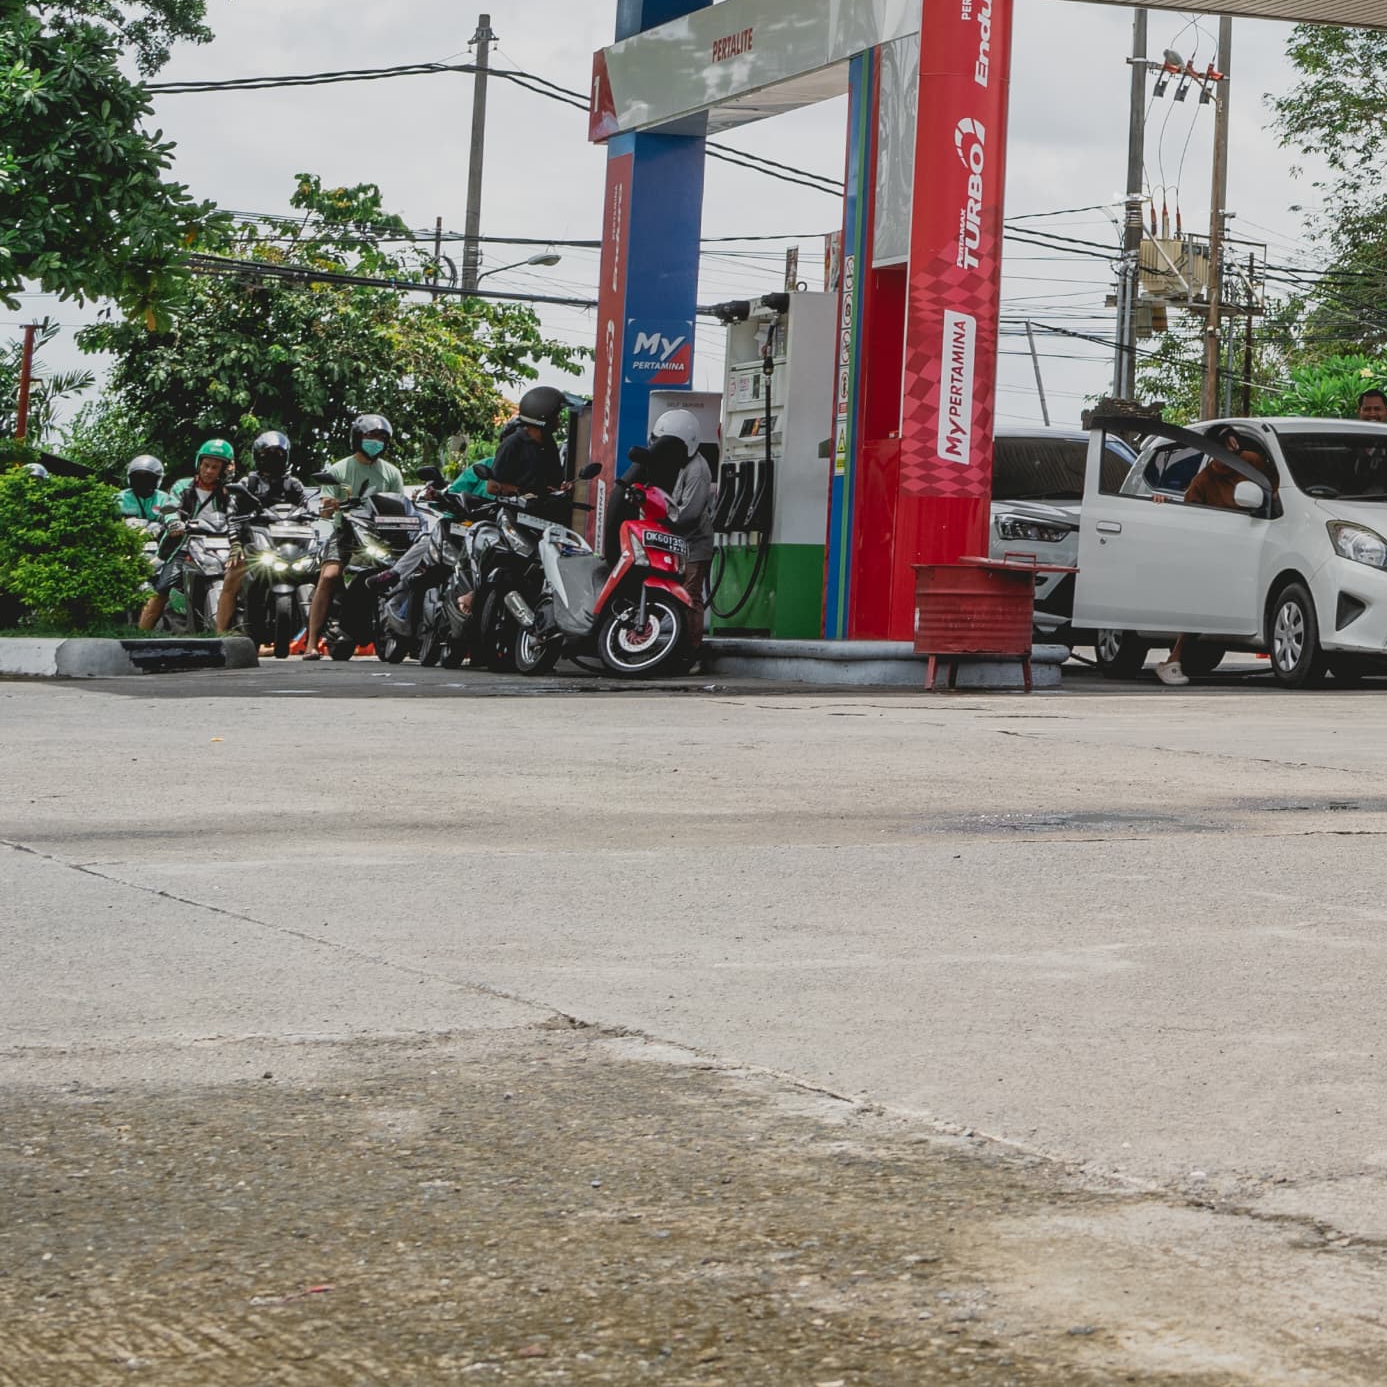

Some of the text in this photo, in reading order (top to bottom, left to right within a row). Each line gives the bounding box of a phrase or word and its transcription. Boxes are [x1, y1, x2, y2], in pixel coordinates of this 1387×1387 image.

[712, 27, 753, 63] PERTALITE
[593, 75, 600, 113] 1
[963, 142, 985, 270] TURBO
[633, 332, 686, 361] My
[632, 361, 685, 371] PERTAMINA
